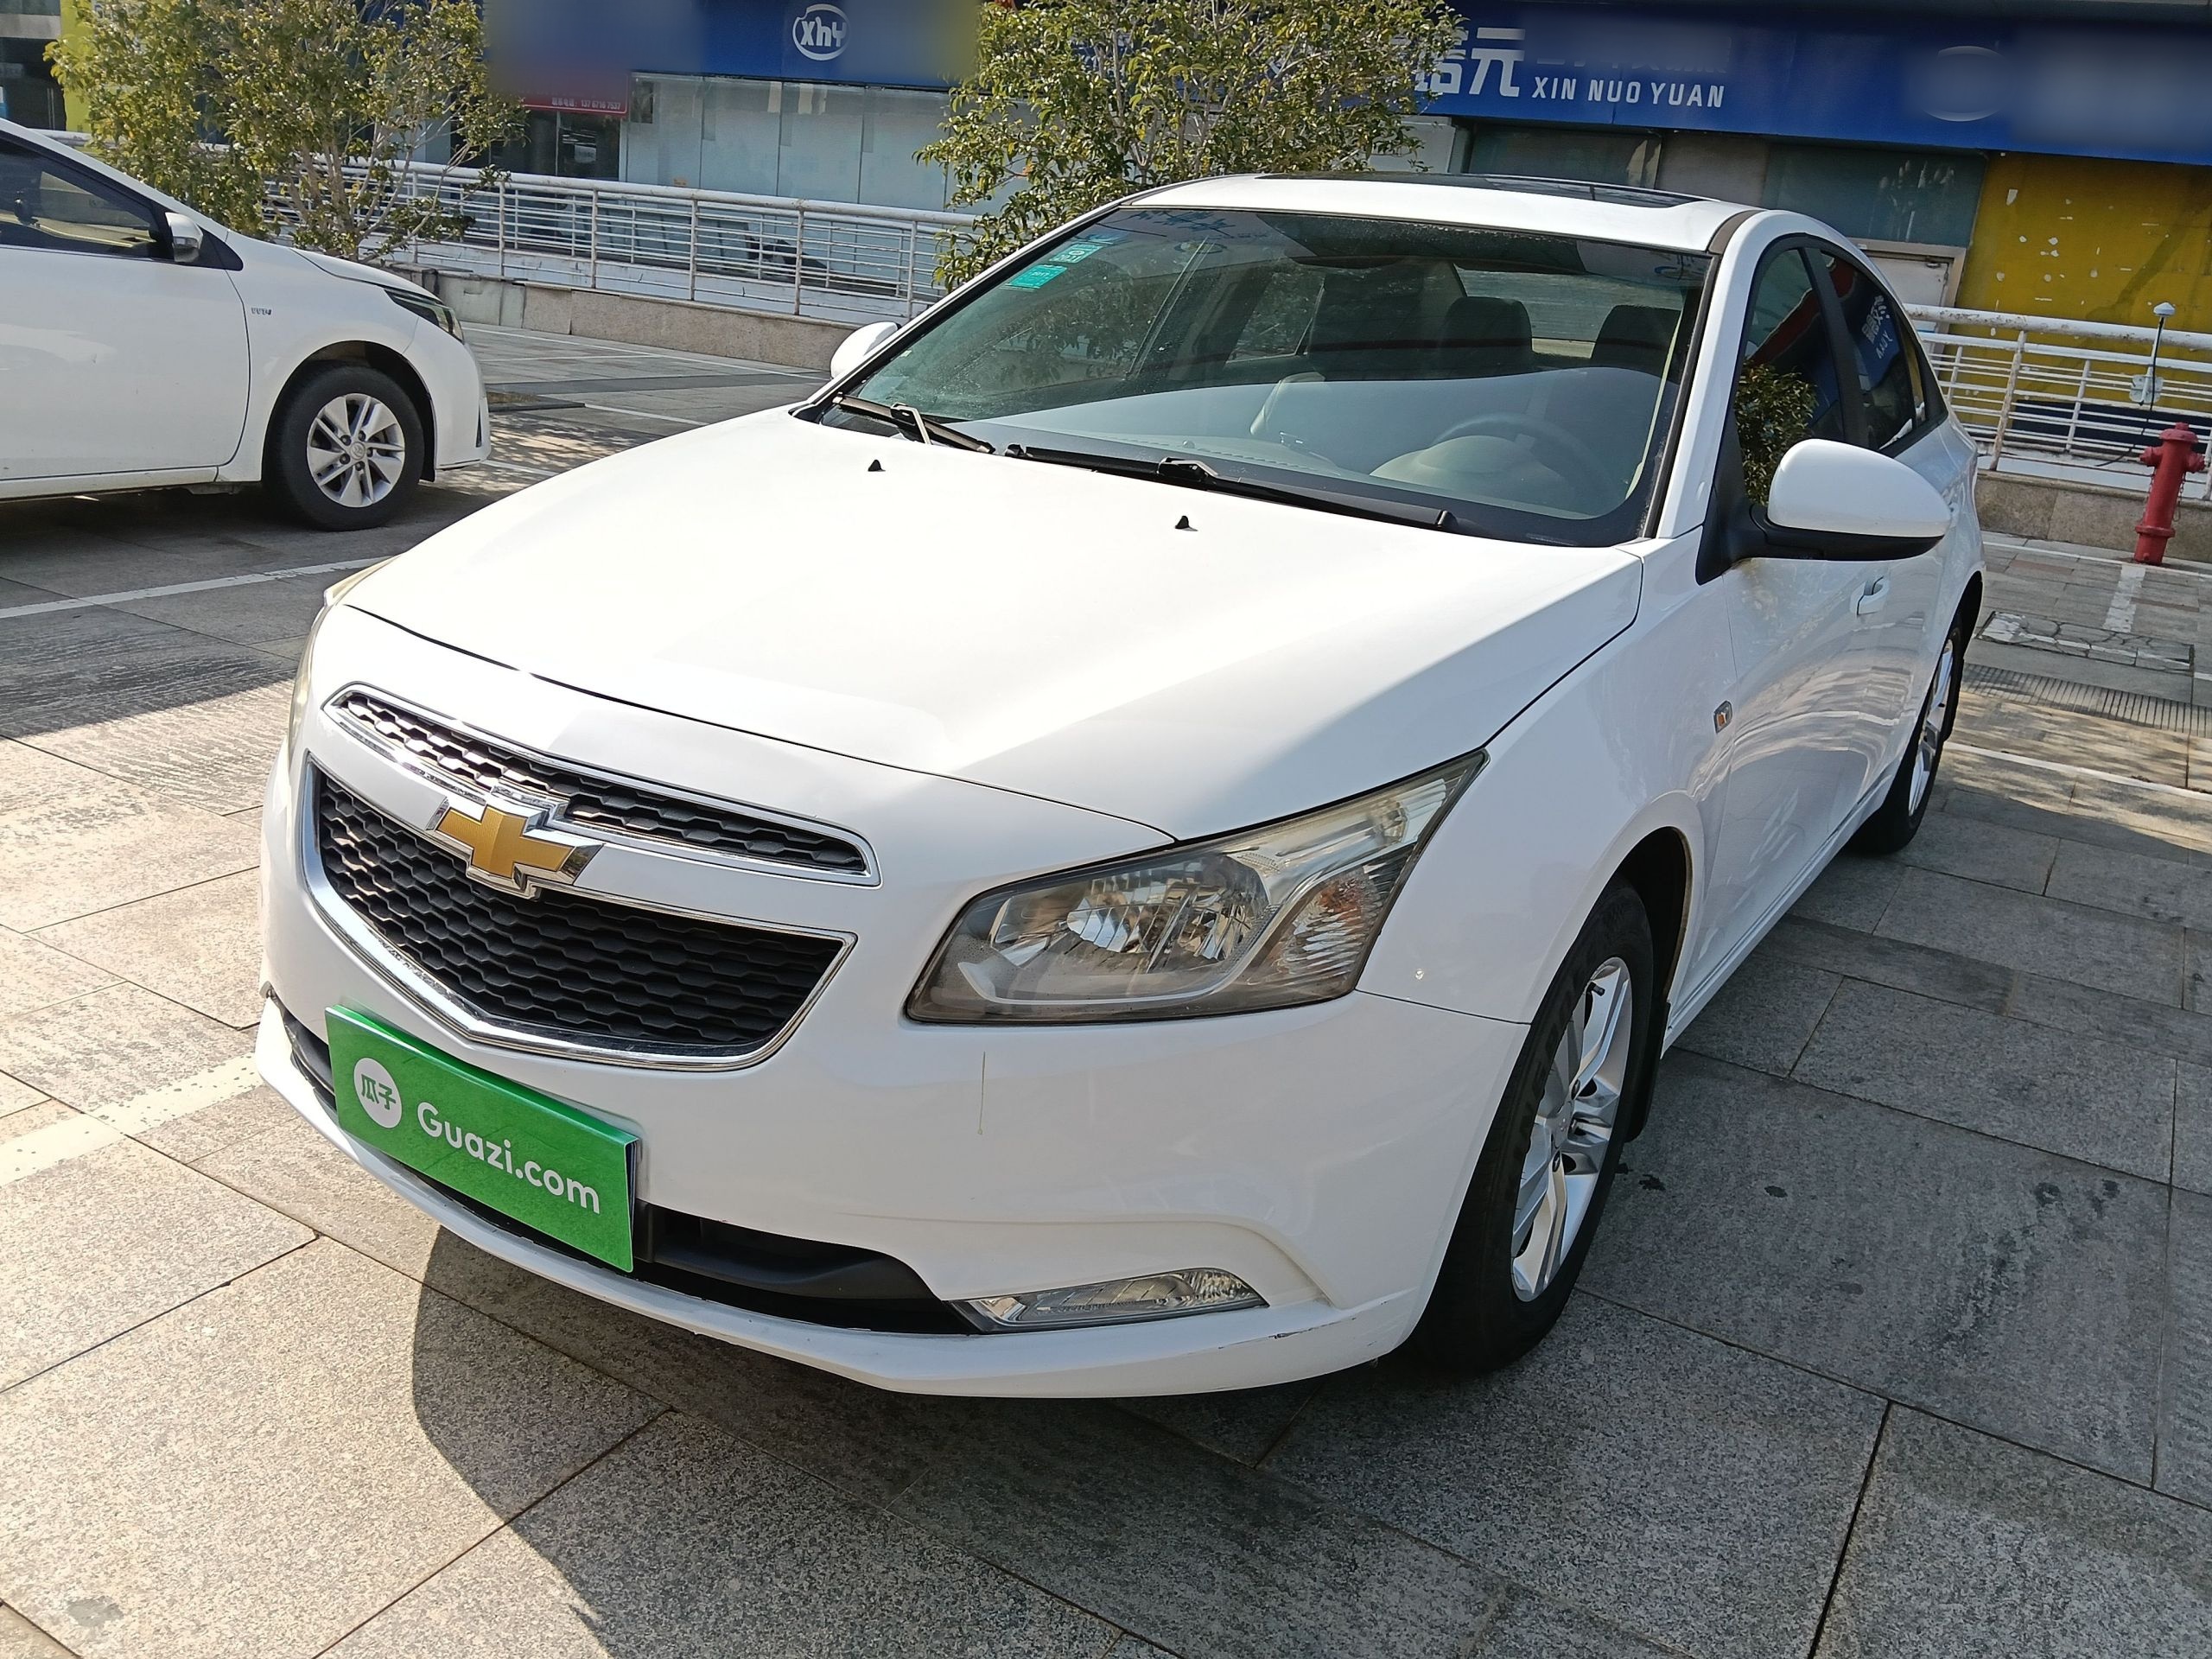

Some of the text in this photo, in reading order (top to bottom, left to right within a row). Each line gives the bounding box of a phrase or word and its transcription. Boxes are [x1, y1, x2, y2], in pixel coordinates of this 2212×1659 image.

[1532, 76, 1725, 108] XIN NUO YUAN
[361, 1073, 600, 1214] 瓜子 Guazi.com
